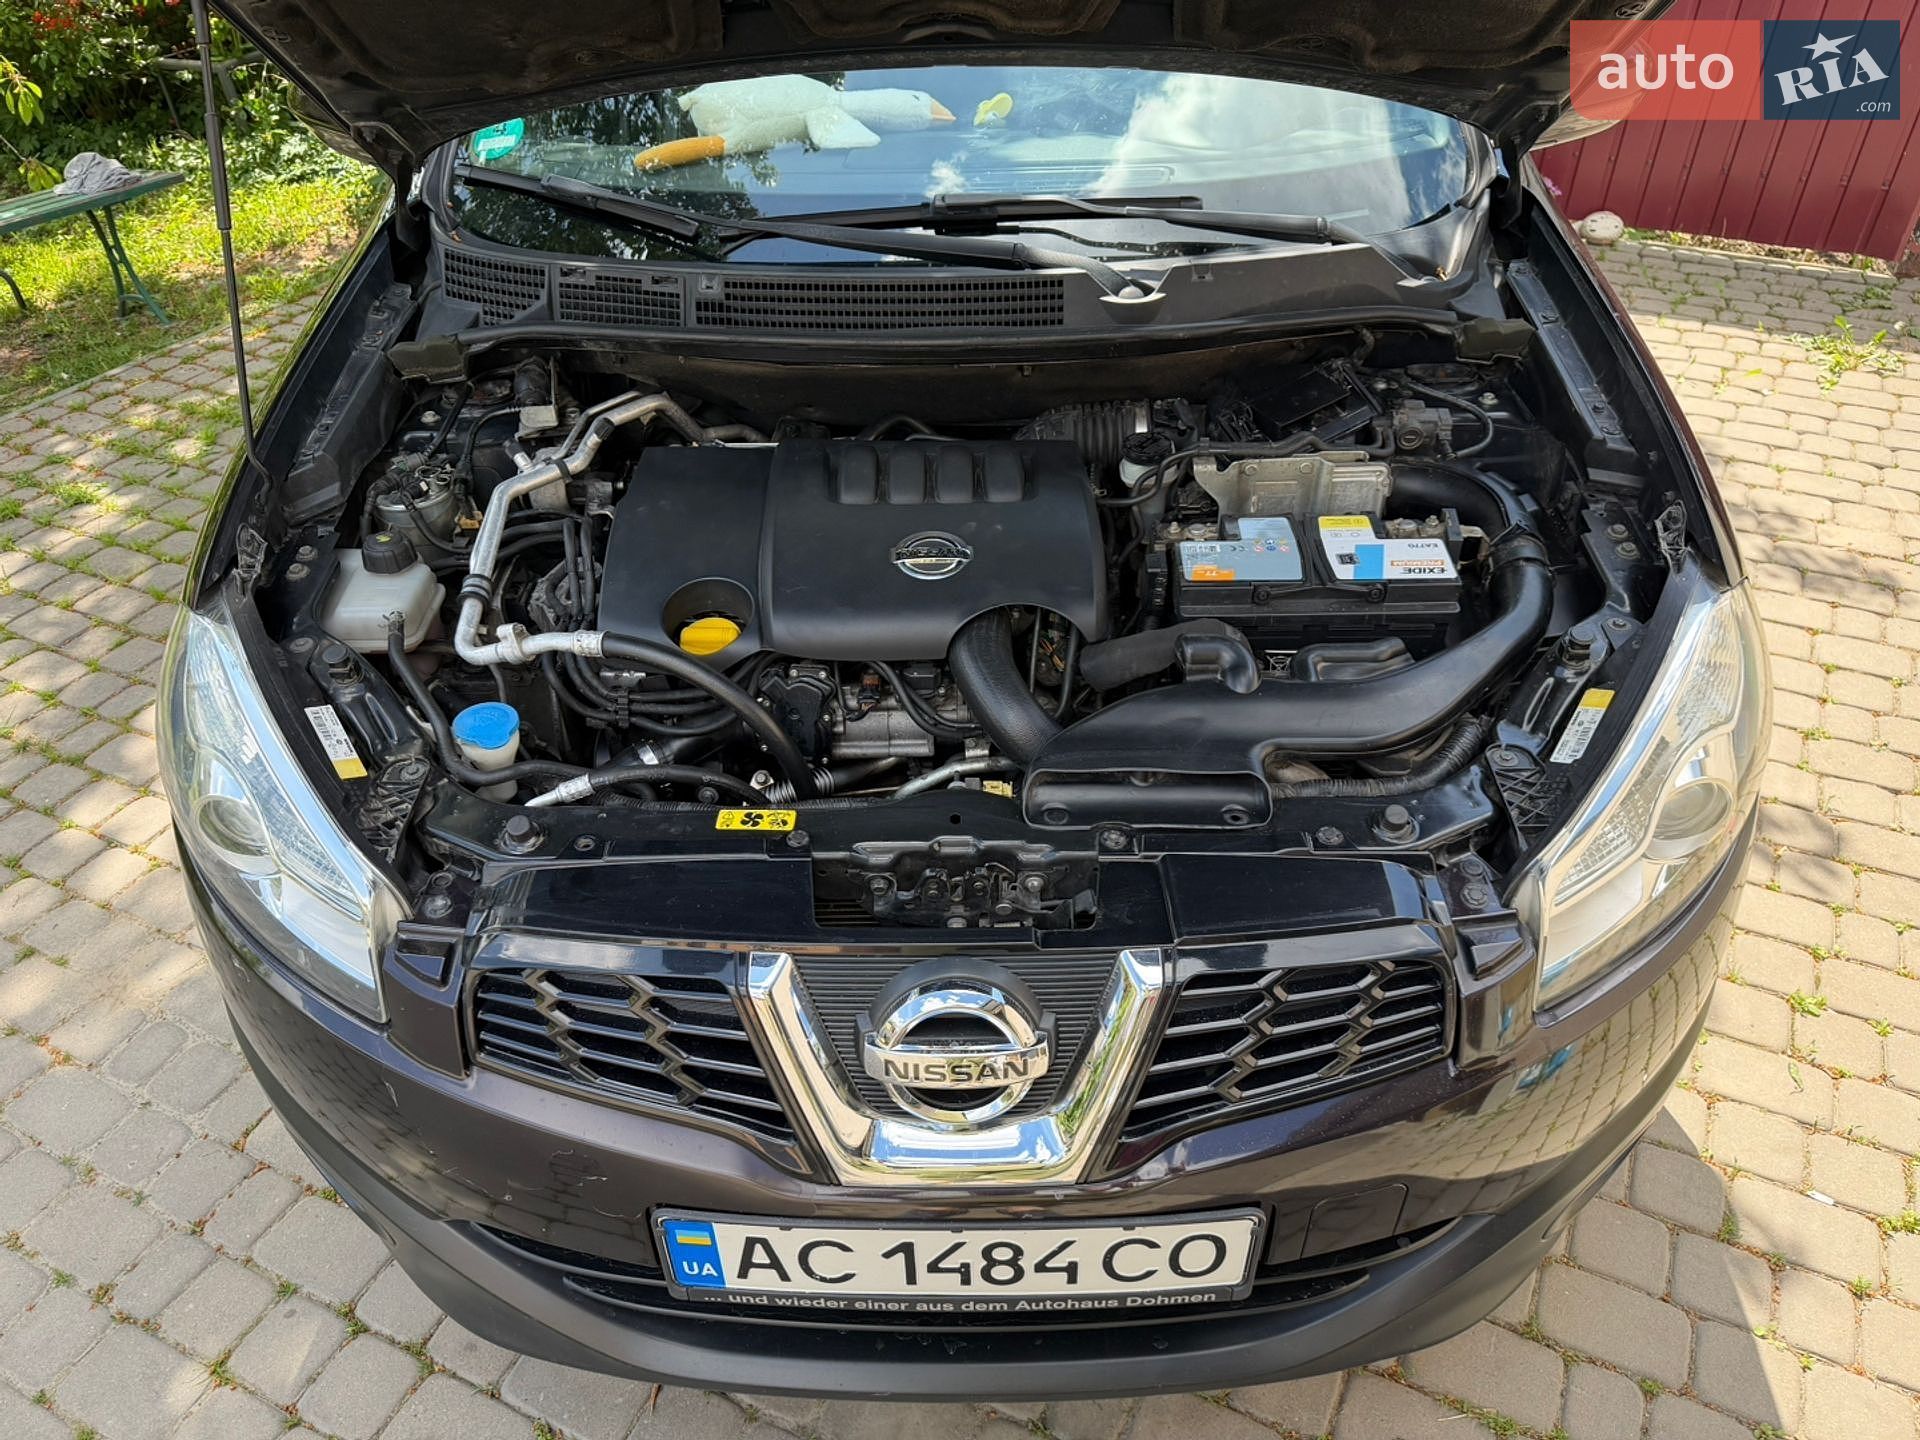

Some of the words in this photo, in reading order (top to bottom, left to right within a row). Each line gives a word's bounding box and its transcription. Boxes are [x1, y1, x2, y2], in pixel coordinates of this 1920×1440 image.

[1400, 566, 1447, 575] EXIDE
[884, 1058, 1029, 1082] NISSAN
[682, 1260, 719, 1277] UA
[736, 1235, 857, 1284] AC
[881, 1239, 1079, 1286] 1484
[1102, 1233, 1227, 1282] CO
[728, 1293, 769, 1306] und
[775, 1296, 848, 1309] wieder
[857, 1299, 909, 1311] einer
[915, 1302, 954, 1312] aus
[961, 1300, 1008, 1312] dem
[1015, 1297, 1119, 1311] Autohaus
[1126, 1291, 1216, 1307] Dohmen
